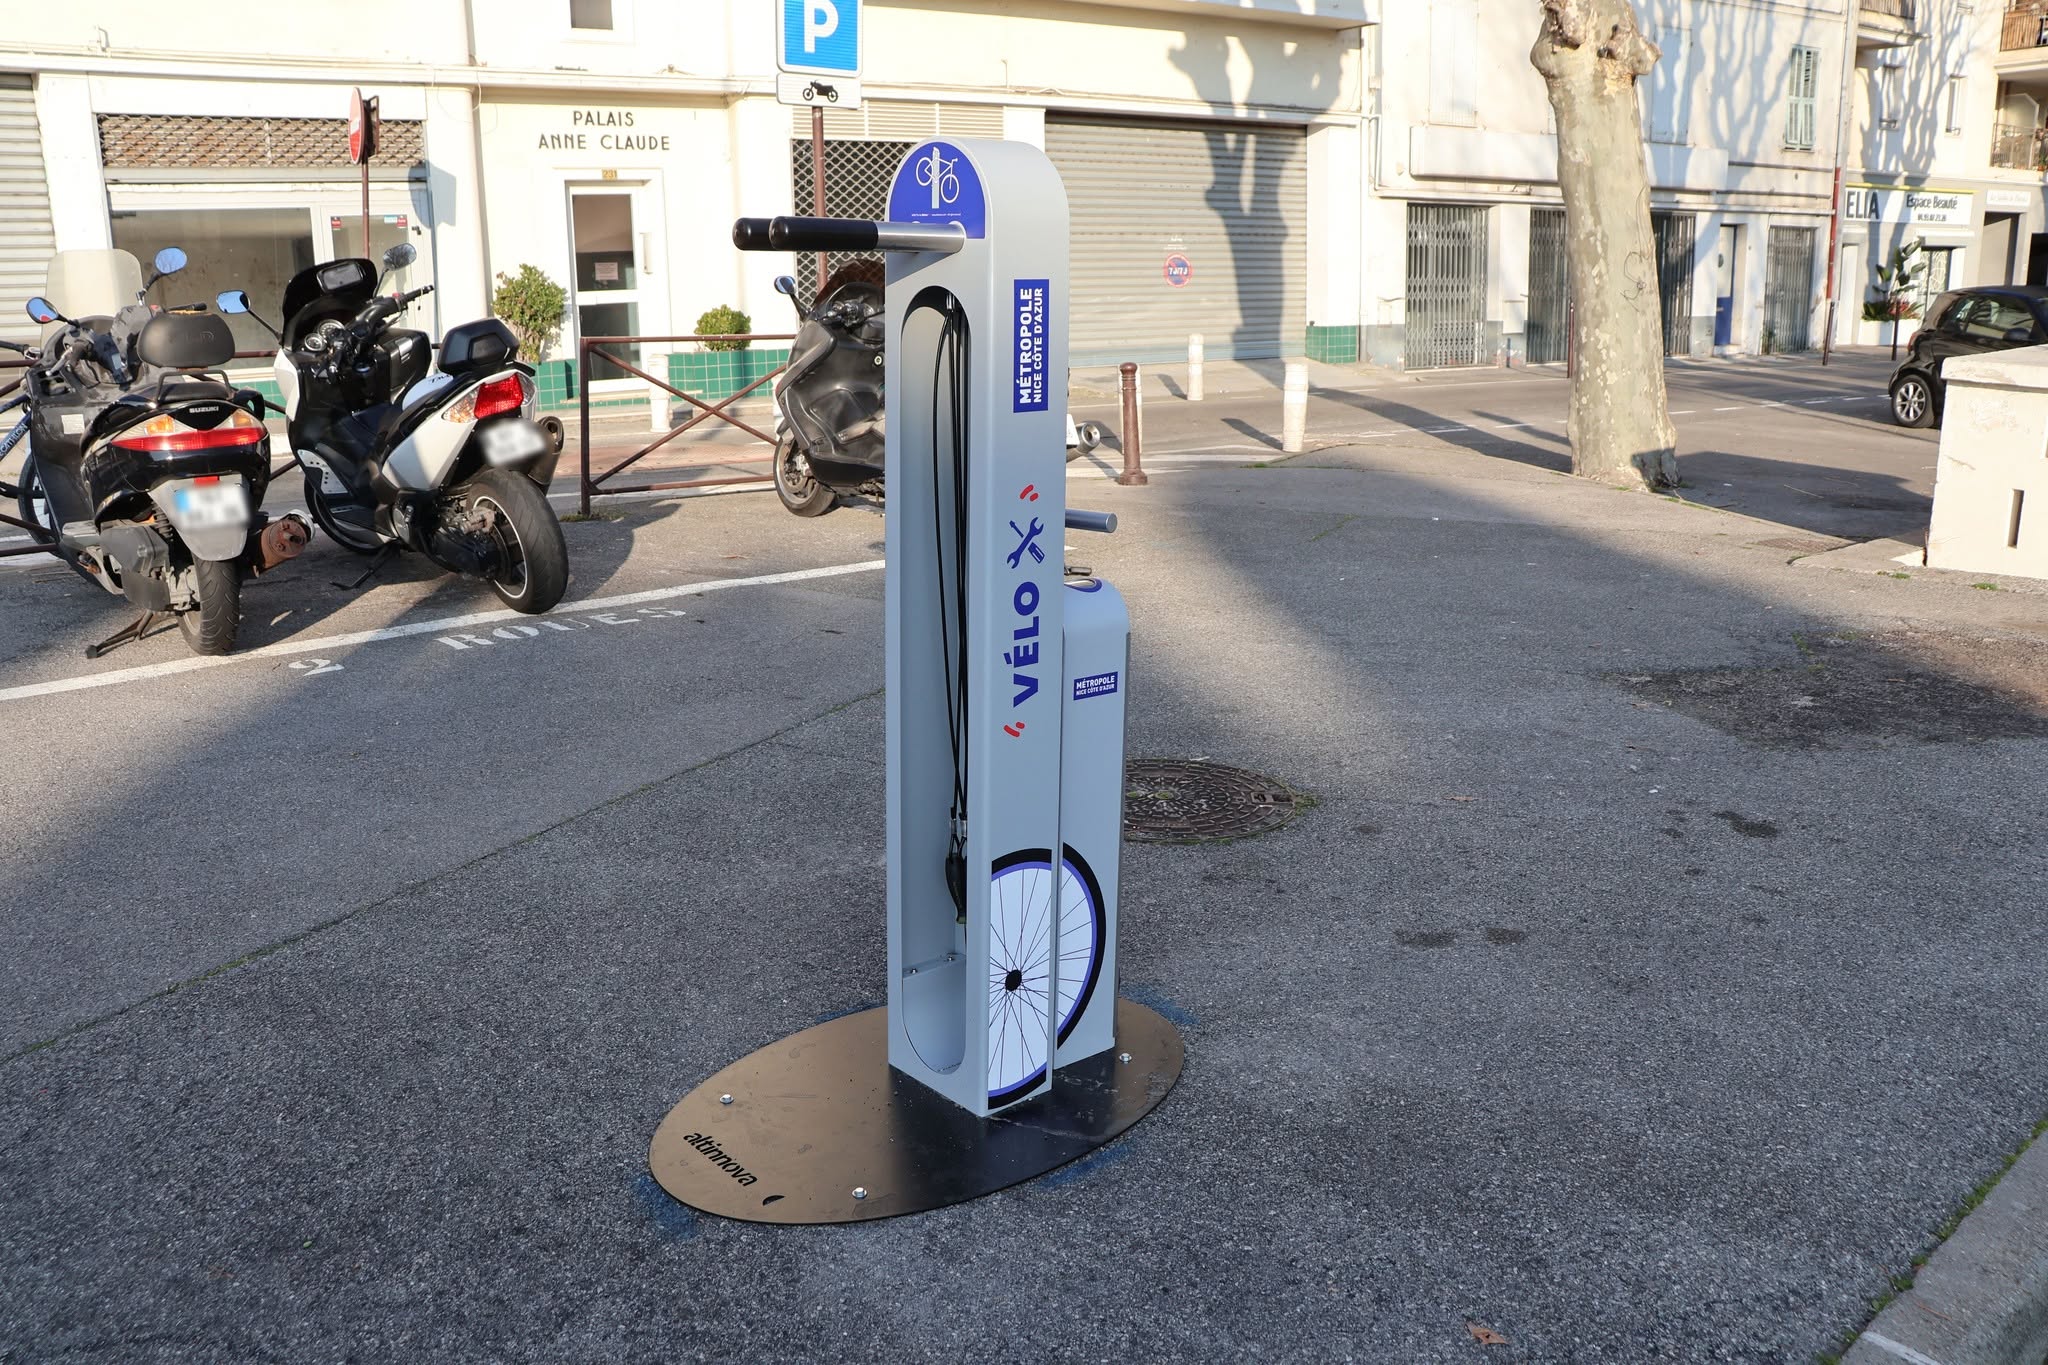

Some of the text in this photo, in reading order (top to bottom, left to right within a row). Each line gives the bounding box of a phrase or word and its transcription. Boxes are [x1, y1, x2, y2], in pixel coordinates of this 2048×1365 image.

[804, 0, 839, 53] P
[573, 110, 634, 127] PALAIS
[538, 133, 670, 151] ANNE CLAUDE
[1846, 191, 1880, 220] ELIA
[1907, 194, 1958, 210] Espace Beauté
[1016, 288, 1032, 404] MÉTROPOLE
[1031, 337, 1042, 370] CÔTE
[1033, 373, 1042, 403] NICE
[288, 607, 687, 677] 2 ROUES
[1003, 581, 1040, 708] VÉLO
[1076, 675, 1115, 690] MÉTROPOLE
[683, 1132, 758, 1187] altinnova
